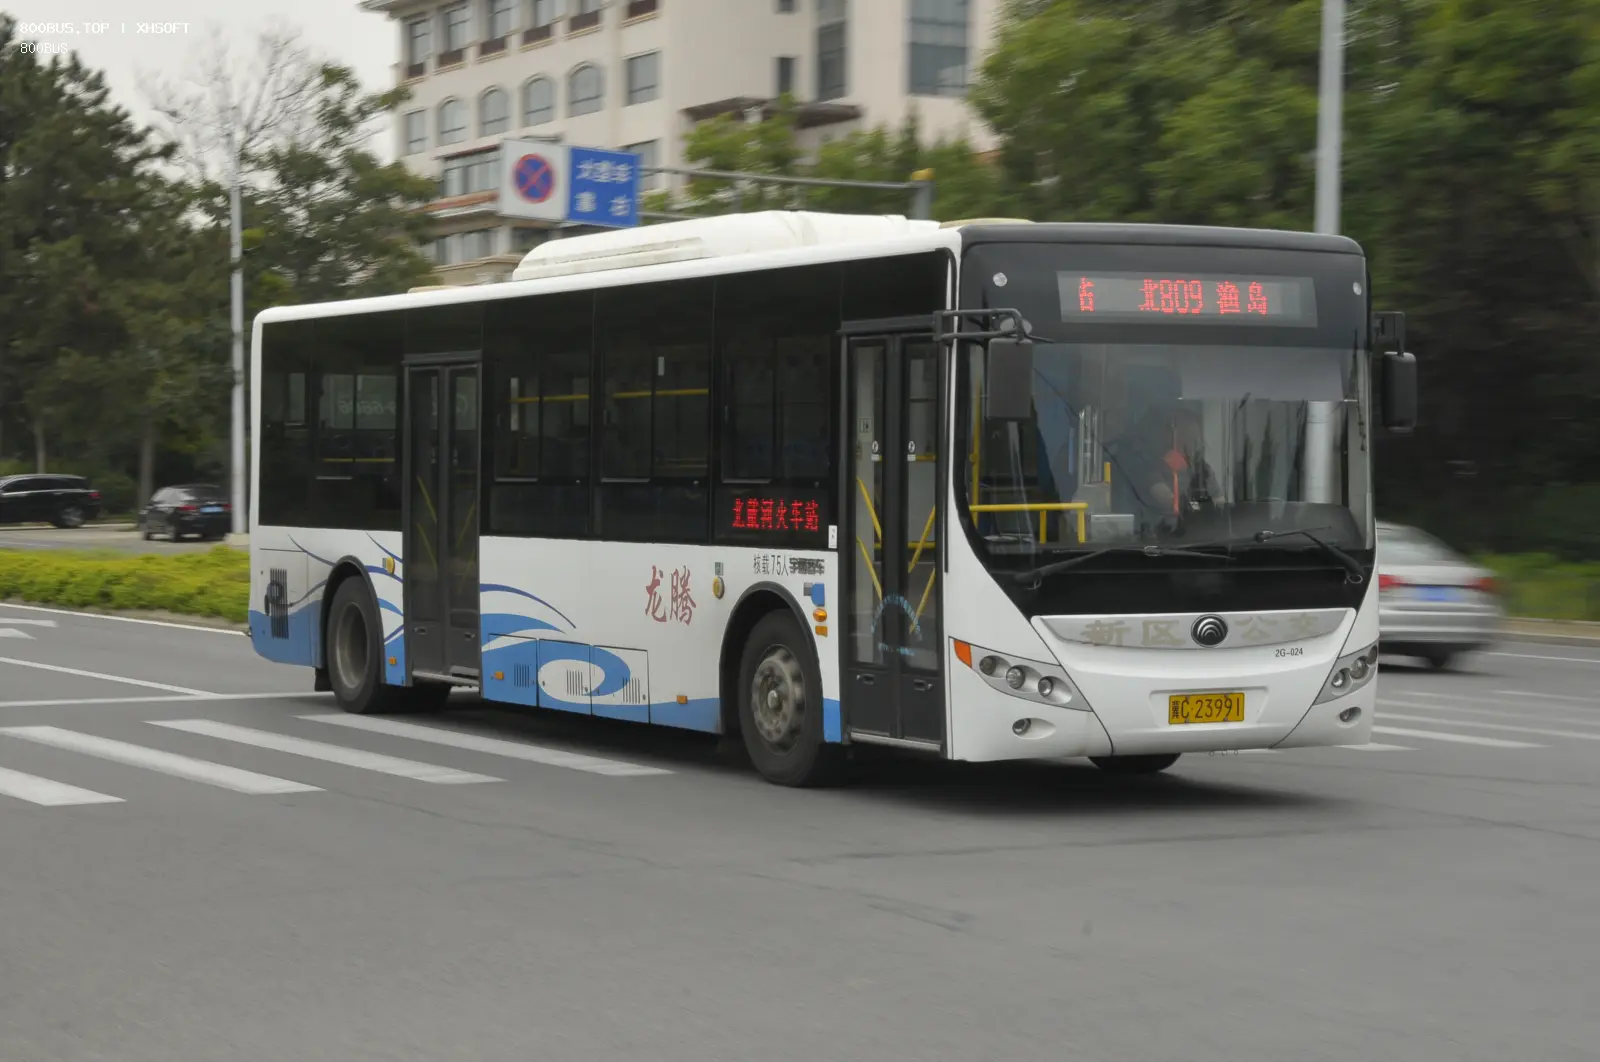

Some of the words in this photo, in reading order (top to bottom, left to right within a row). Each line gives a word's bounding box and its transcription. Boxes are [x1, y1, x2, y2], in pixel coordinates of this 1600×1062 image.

[731, 498, 819, 532] 北戴河火车站
[644, 565, 697, 626] 龙腾
[1275, 647, 1304, 658] 2G-024
